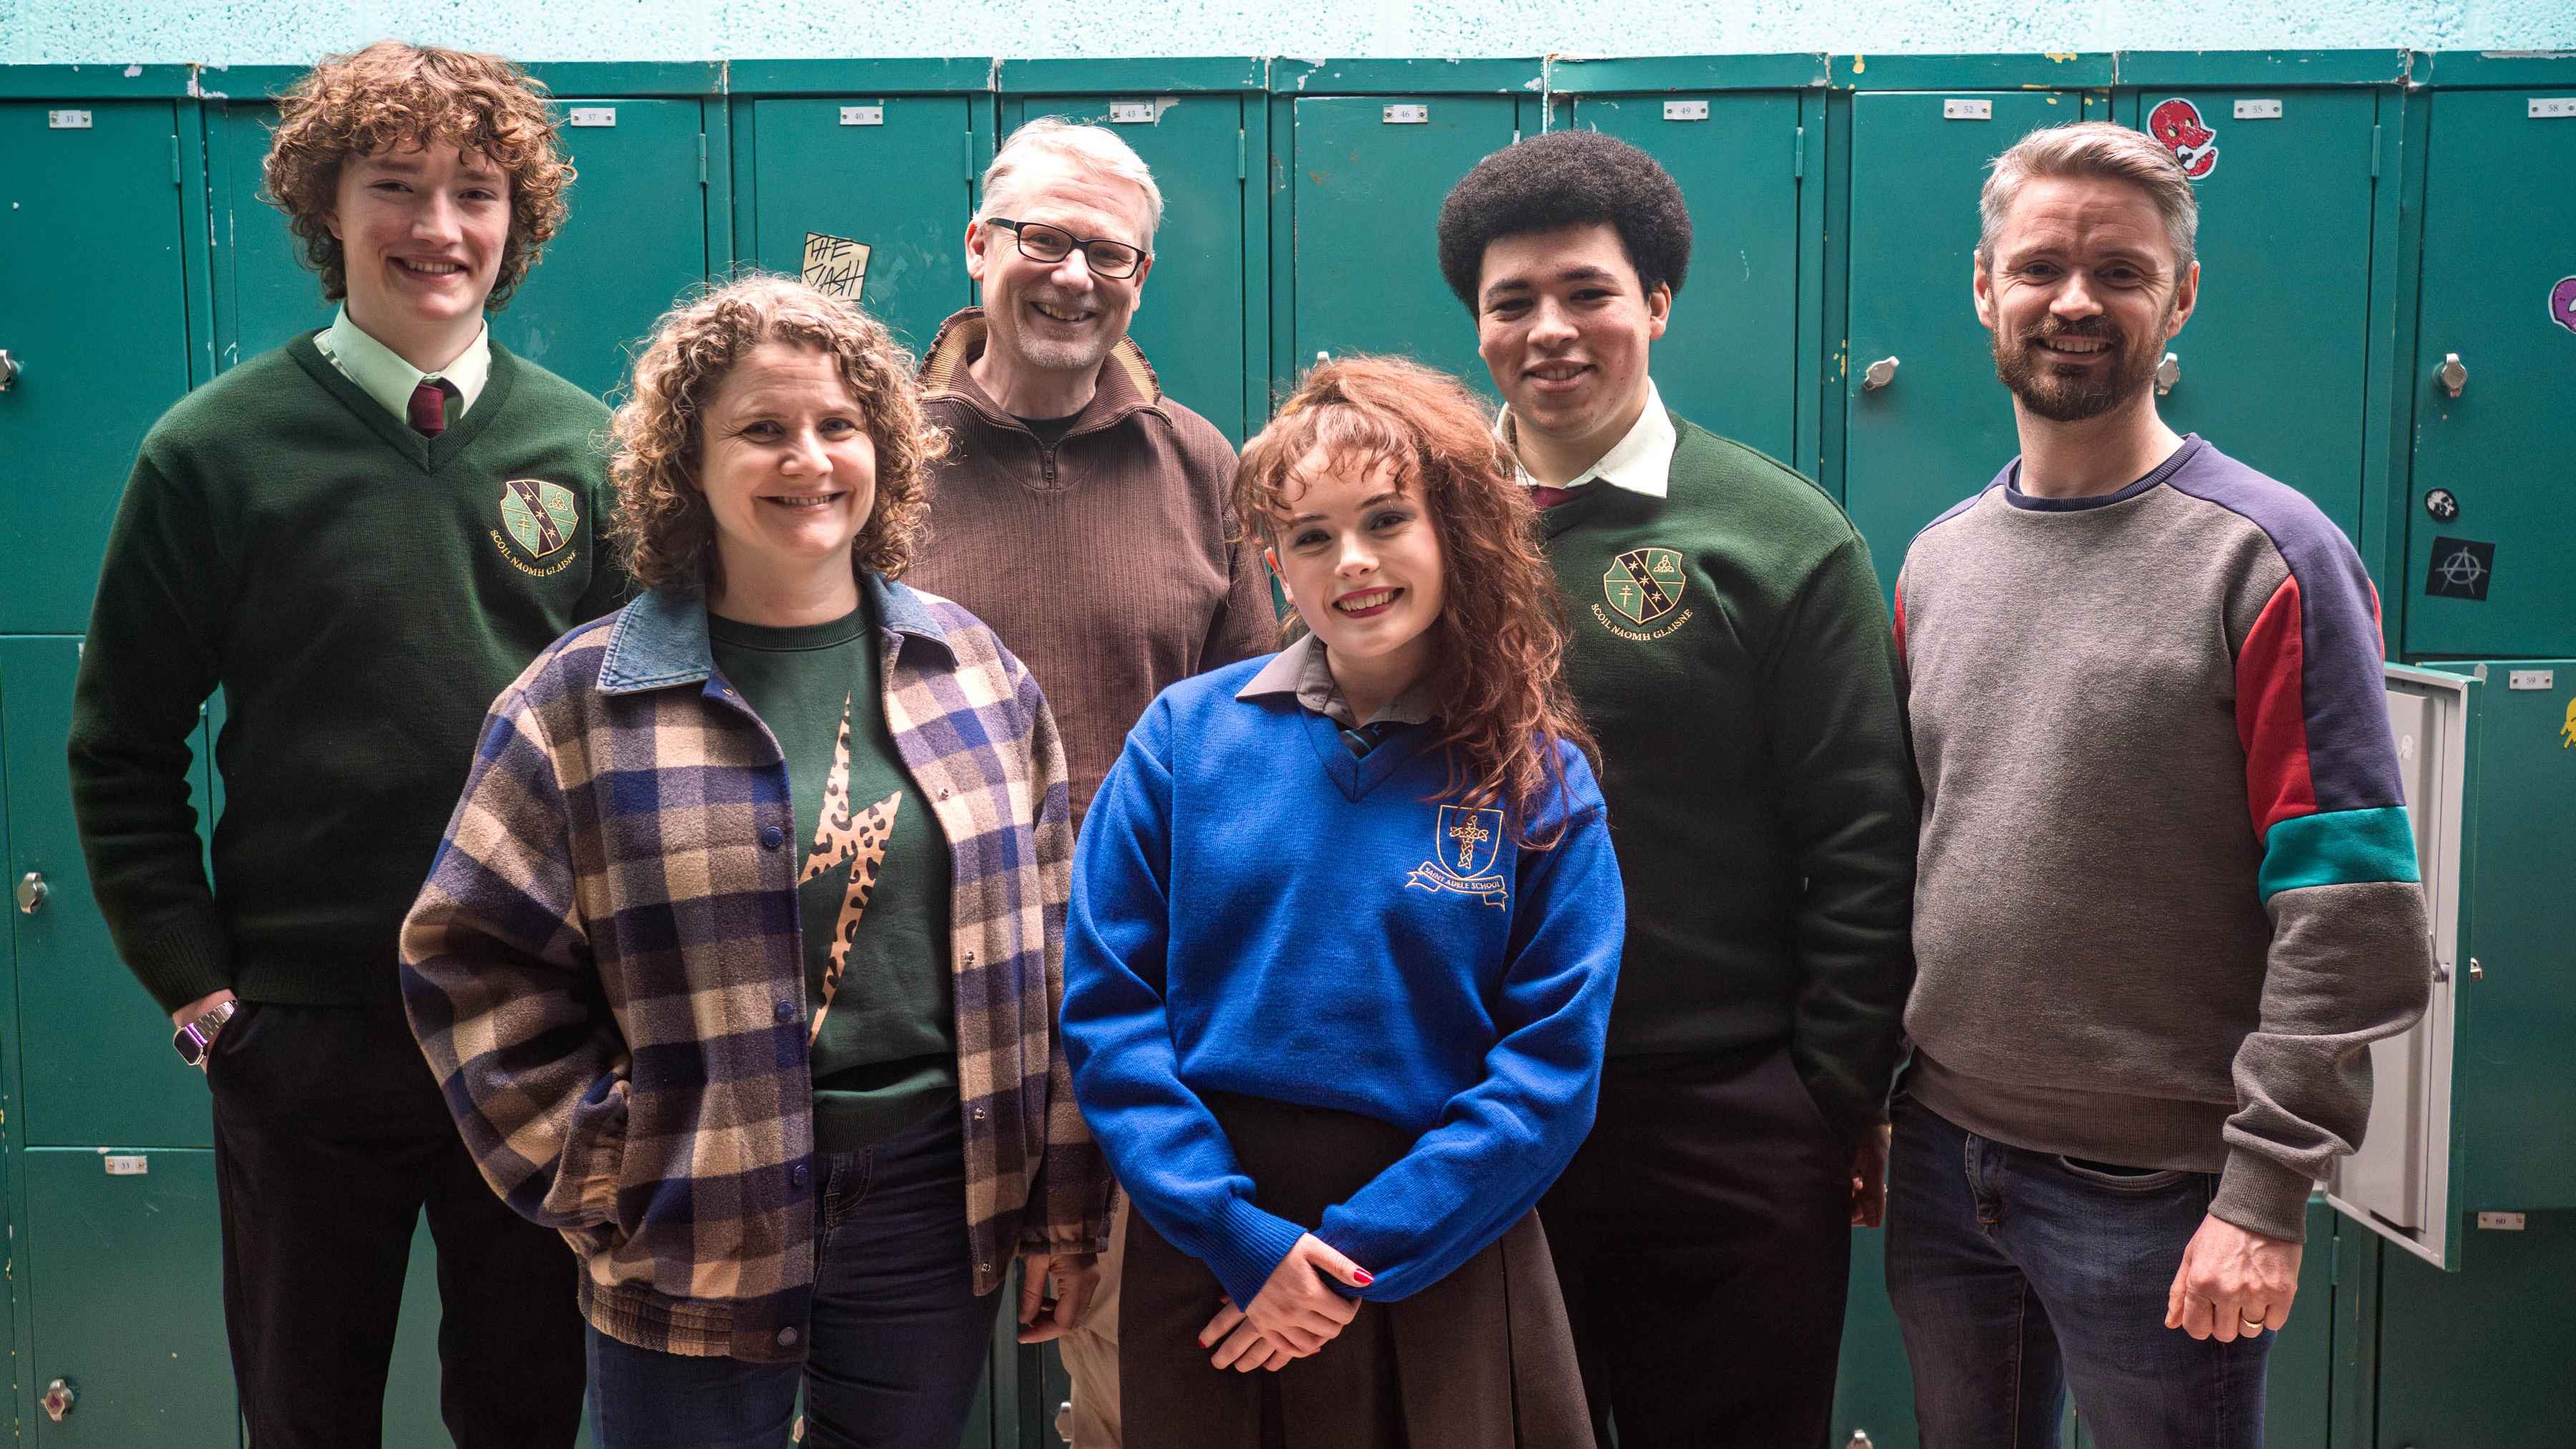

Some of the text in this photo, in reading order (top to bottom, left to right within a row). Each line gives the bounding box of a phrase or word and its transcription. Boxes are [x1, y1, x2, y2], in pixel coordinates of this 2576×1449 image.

[67, 114, 74, 123] 31
[2253, 105, 2263, 114] 55
[2548, 104, 2558, 112] 58
[805, 235, 854, 262] THE
[804, 259, 865, 297] CLASH
[490, 529, 512, 559] SCOIL
[510, 556, 545, 577] NAOMH
[1591, 603, 1693, 641] SCOIL NAOMH GLAISNE
[2526, 676, 2536, 685] 59
[1424, 867, 1501, 889] SAINT ADELE SCHOOL
